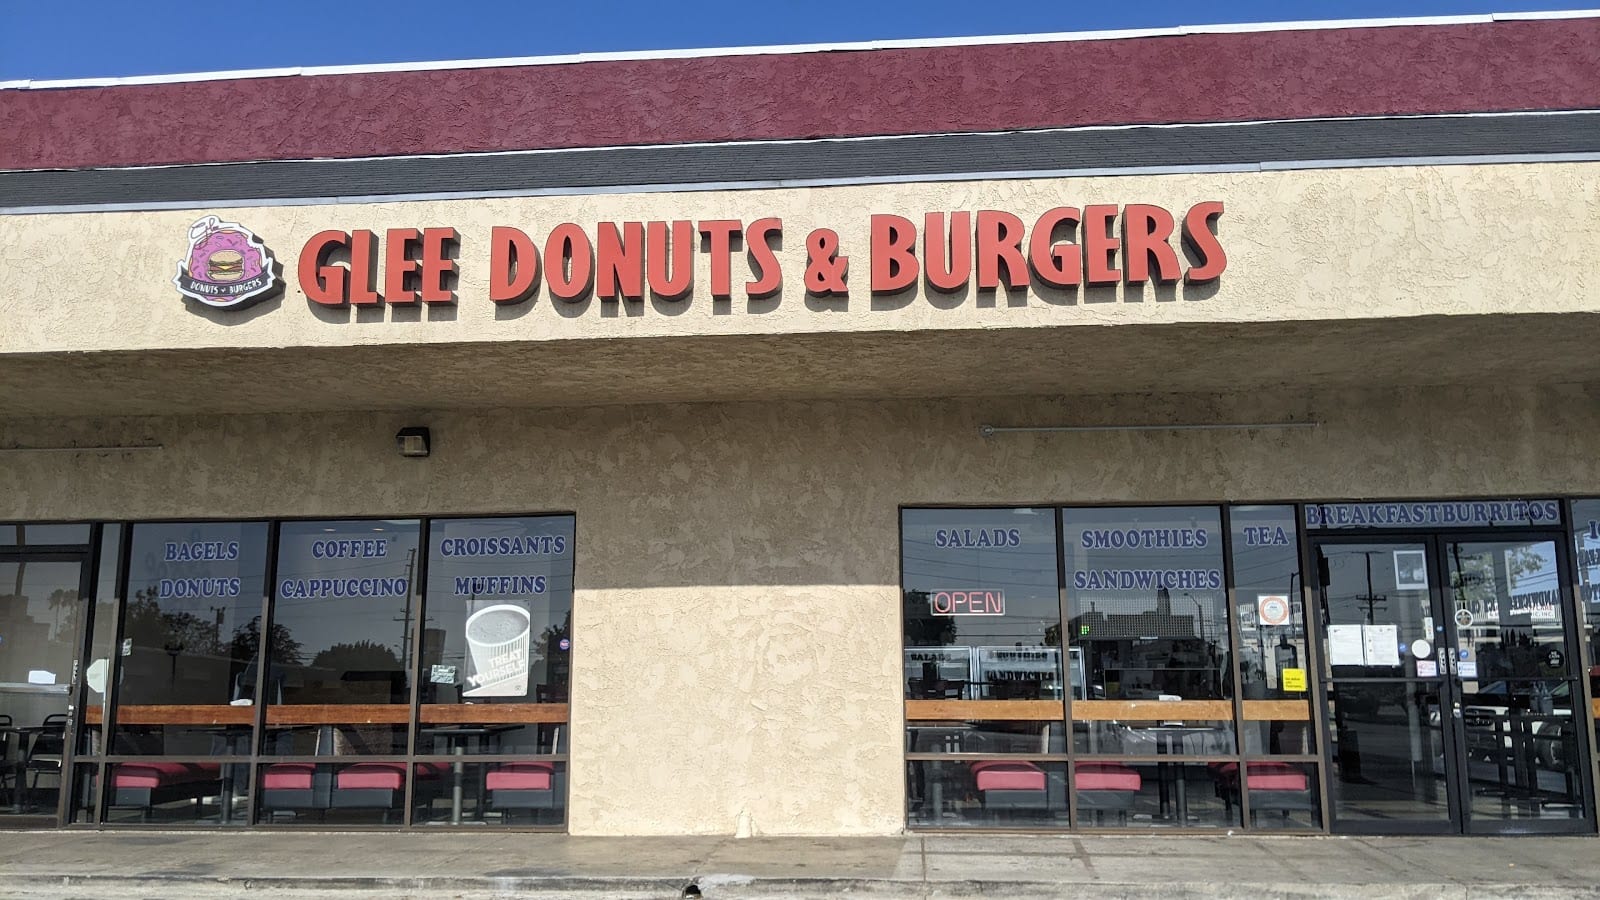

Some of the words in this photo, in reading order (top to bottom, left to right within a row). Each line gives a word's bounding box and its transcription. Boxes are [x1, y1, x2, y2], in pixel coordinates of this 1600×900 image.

[298, 226, 459, 305] GLEE
[490, 217, 783, 301] DONUTS
[804, 228, 848, 294] &
[870, 201, 1227, 292] BURGERS
[190, 281, 218, 294] DONUTS
[229, 278, 262, 294] BURGERS
[440, 535, 566, 556] CROISSANTS
[935, 528, 1021, 548] SALADS
[1081, 529, 1208, 549] SMOOTHIES
[1243, 526, 1289, 546] TEA
[164, 541, 239, 561] BAGELS
[311, 538, 388, 559] COFFEE
[159, 577, 240, 598] DONUTS
[280, 577, 408, 599] CAPPUCCINO
[454, 575, 546, 595] MUFFINS
[1074, 569, 1222, 590] SANDWICHES
[934, 591, 1002, 613] OPEN
[488, 649, 521, 668] TREAT
[466, 659, 525, 686] YOURSELF
